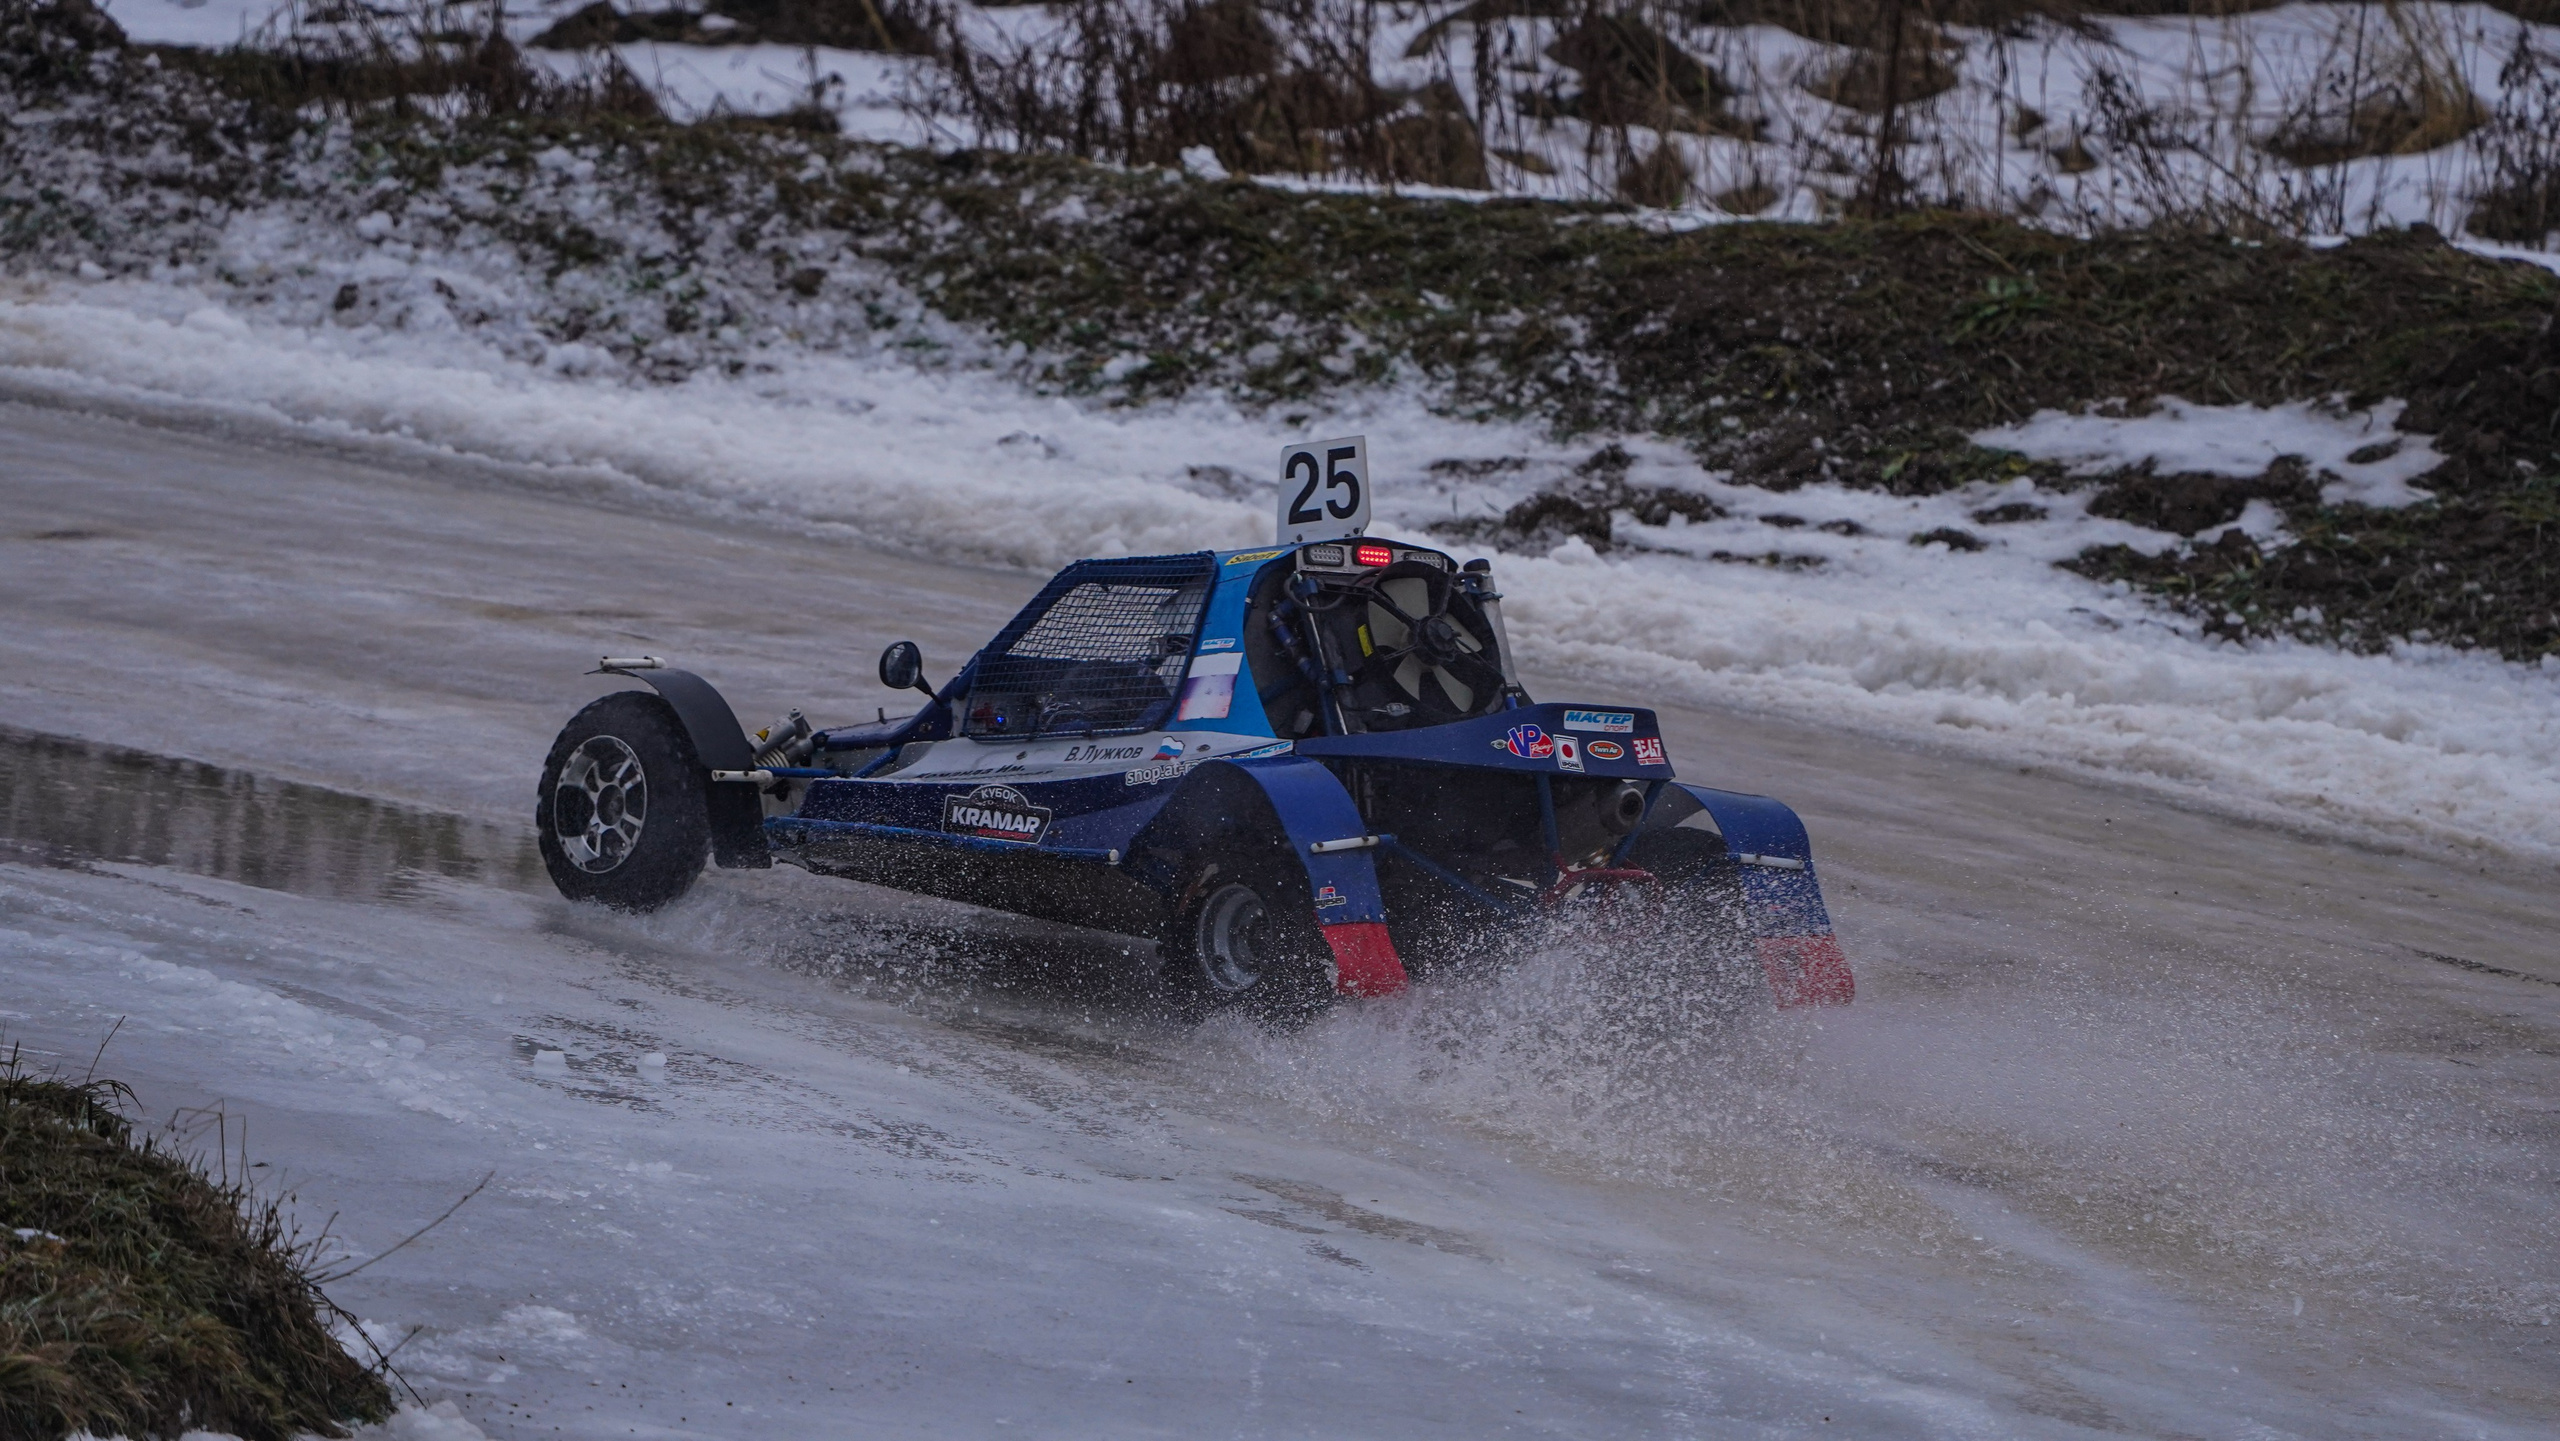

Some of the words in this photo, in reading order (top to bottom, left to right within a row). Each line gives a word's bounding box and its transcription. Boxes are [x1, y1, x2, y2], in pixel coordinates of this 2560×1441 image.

[1285, 446, 1360, 525] 25
[1565, 711, 1633, 725] МАСТЕР
[1508, 724, 1542, 758] VP
[1593, 745, 1609, 753] Twin
[1064, 745, 1144, 763] В.Лужков
[981, 787, 1018, 803] КУБОК
[951, 806, 1041, 833] KRAMAR
